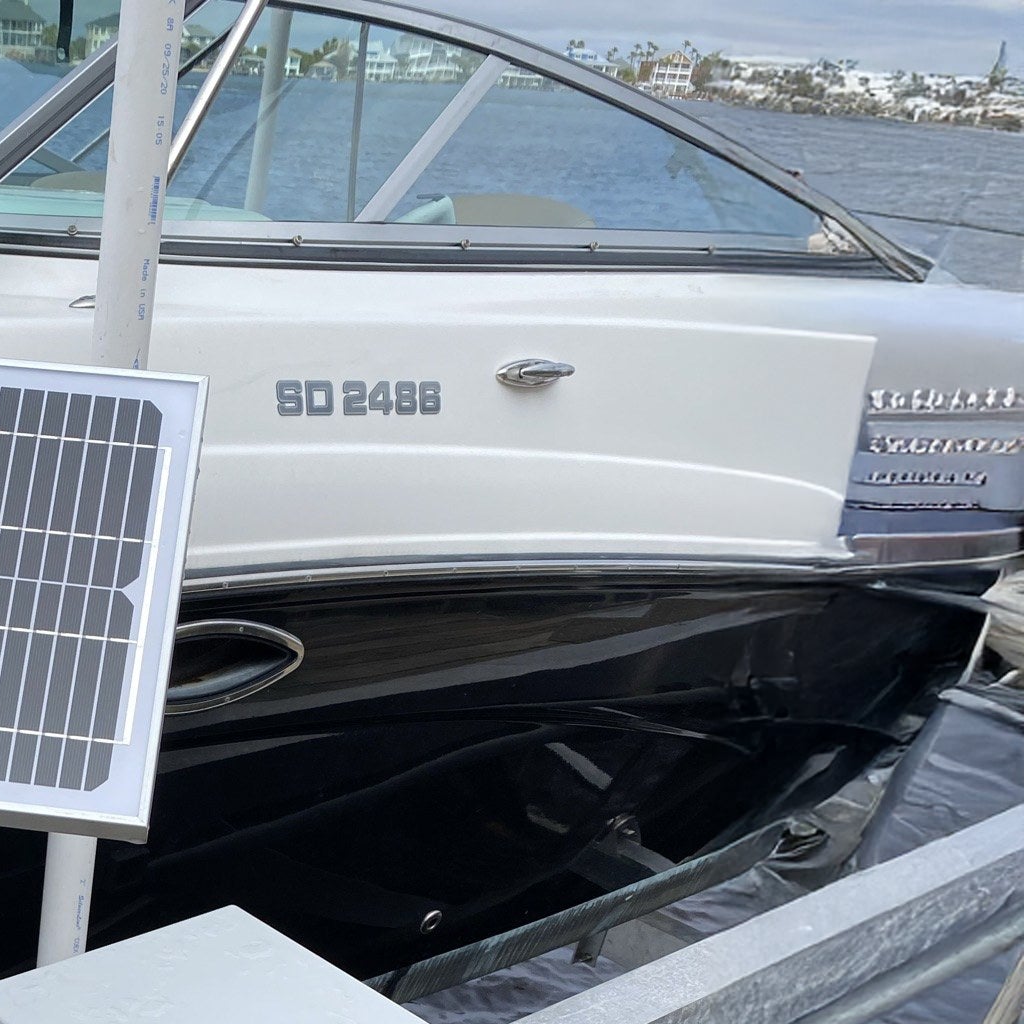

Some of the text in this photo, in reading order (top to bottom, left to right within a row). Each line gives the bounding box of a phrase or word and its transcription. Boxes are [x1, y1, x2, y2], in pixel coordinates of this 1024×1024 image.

[160, 43, 172, 95] 09/25/20
[138, 259, 150, 320] Made in USA
[276, 380, 442, 416] SD 2486
